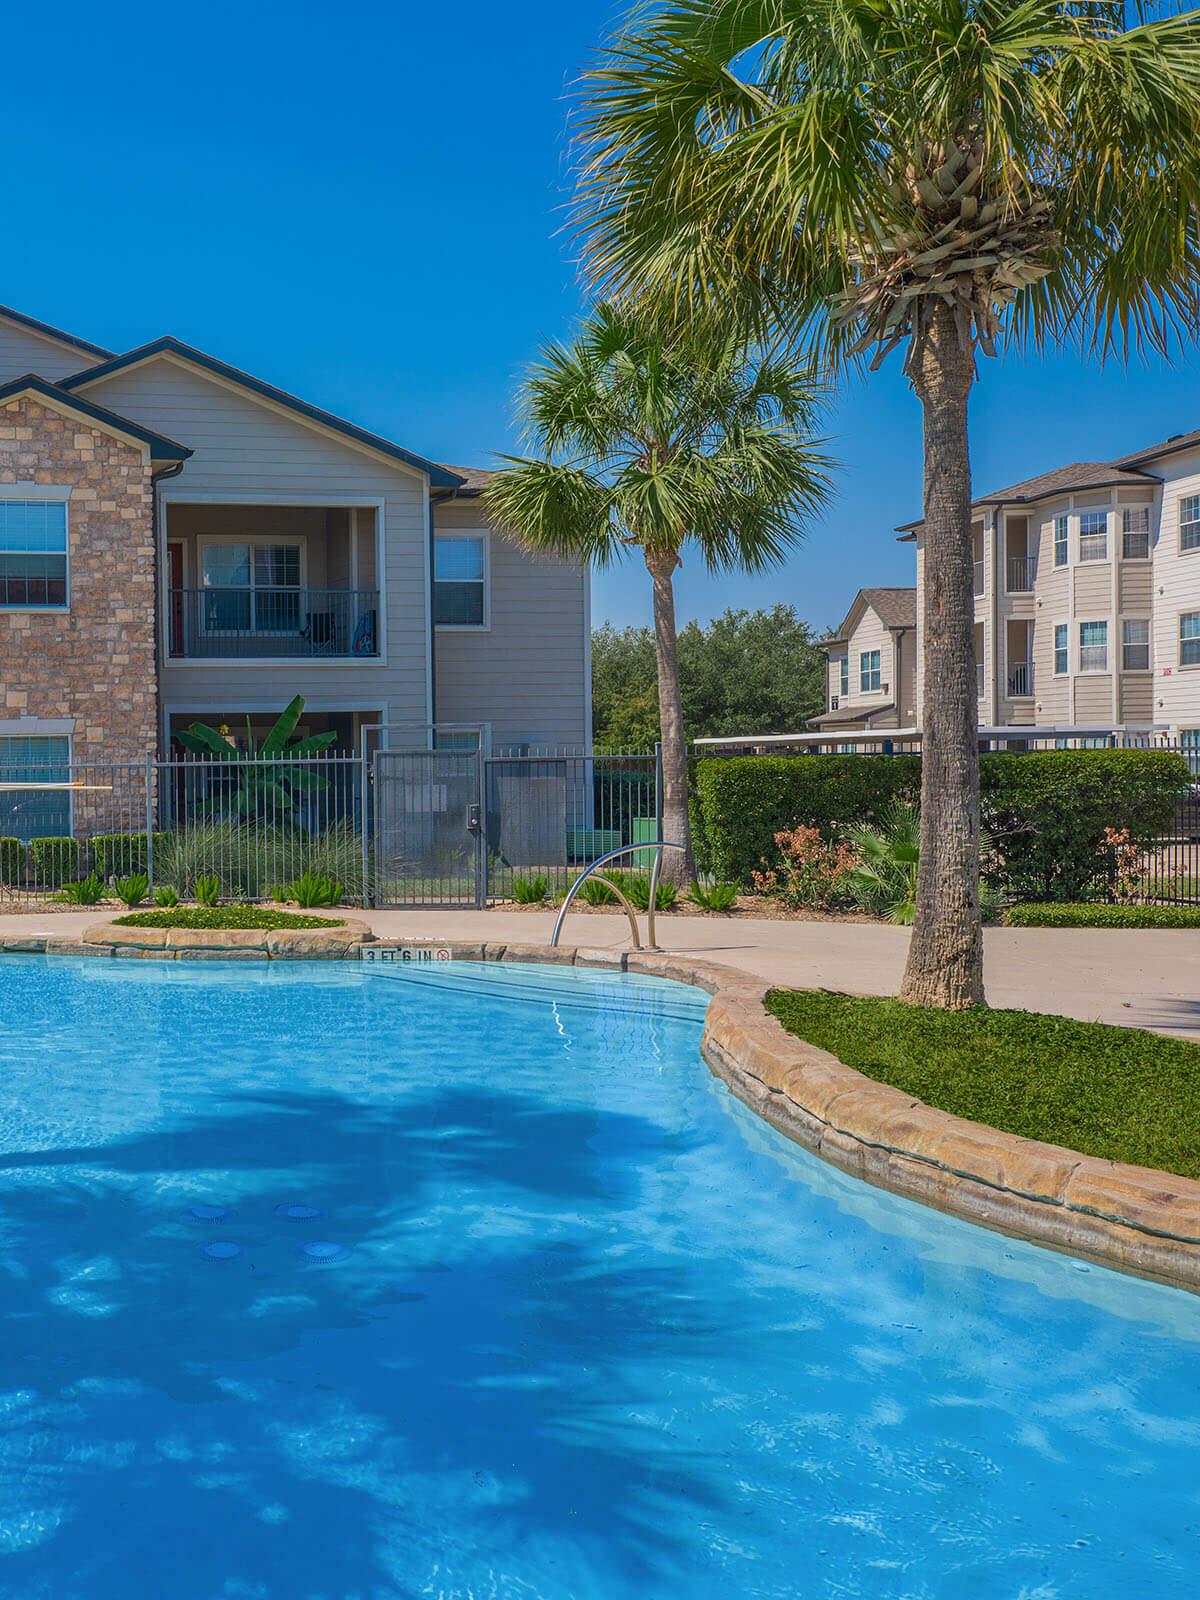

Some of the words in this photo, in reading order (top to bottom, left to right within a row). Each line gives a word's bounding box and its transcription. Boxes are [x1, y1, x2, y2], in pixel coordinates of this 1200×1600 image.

[367, 951, 375, 960] 3
[402, 951, 411, 960] 6
[418, 951, 431, 961] IN
